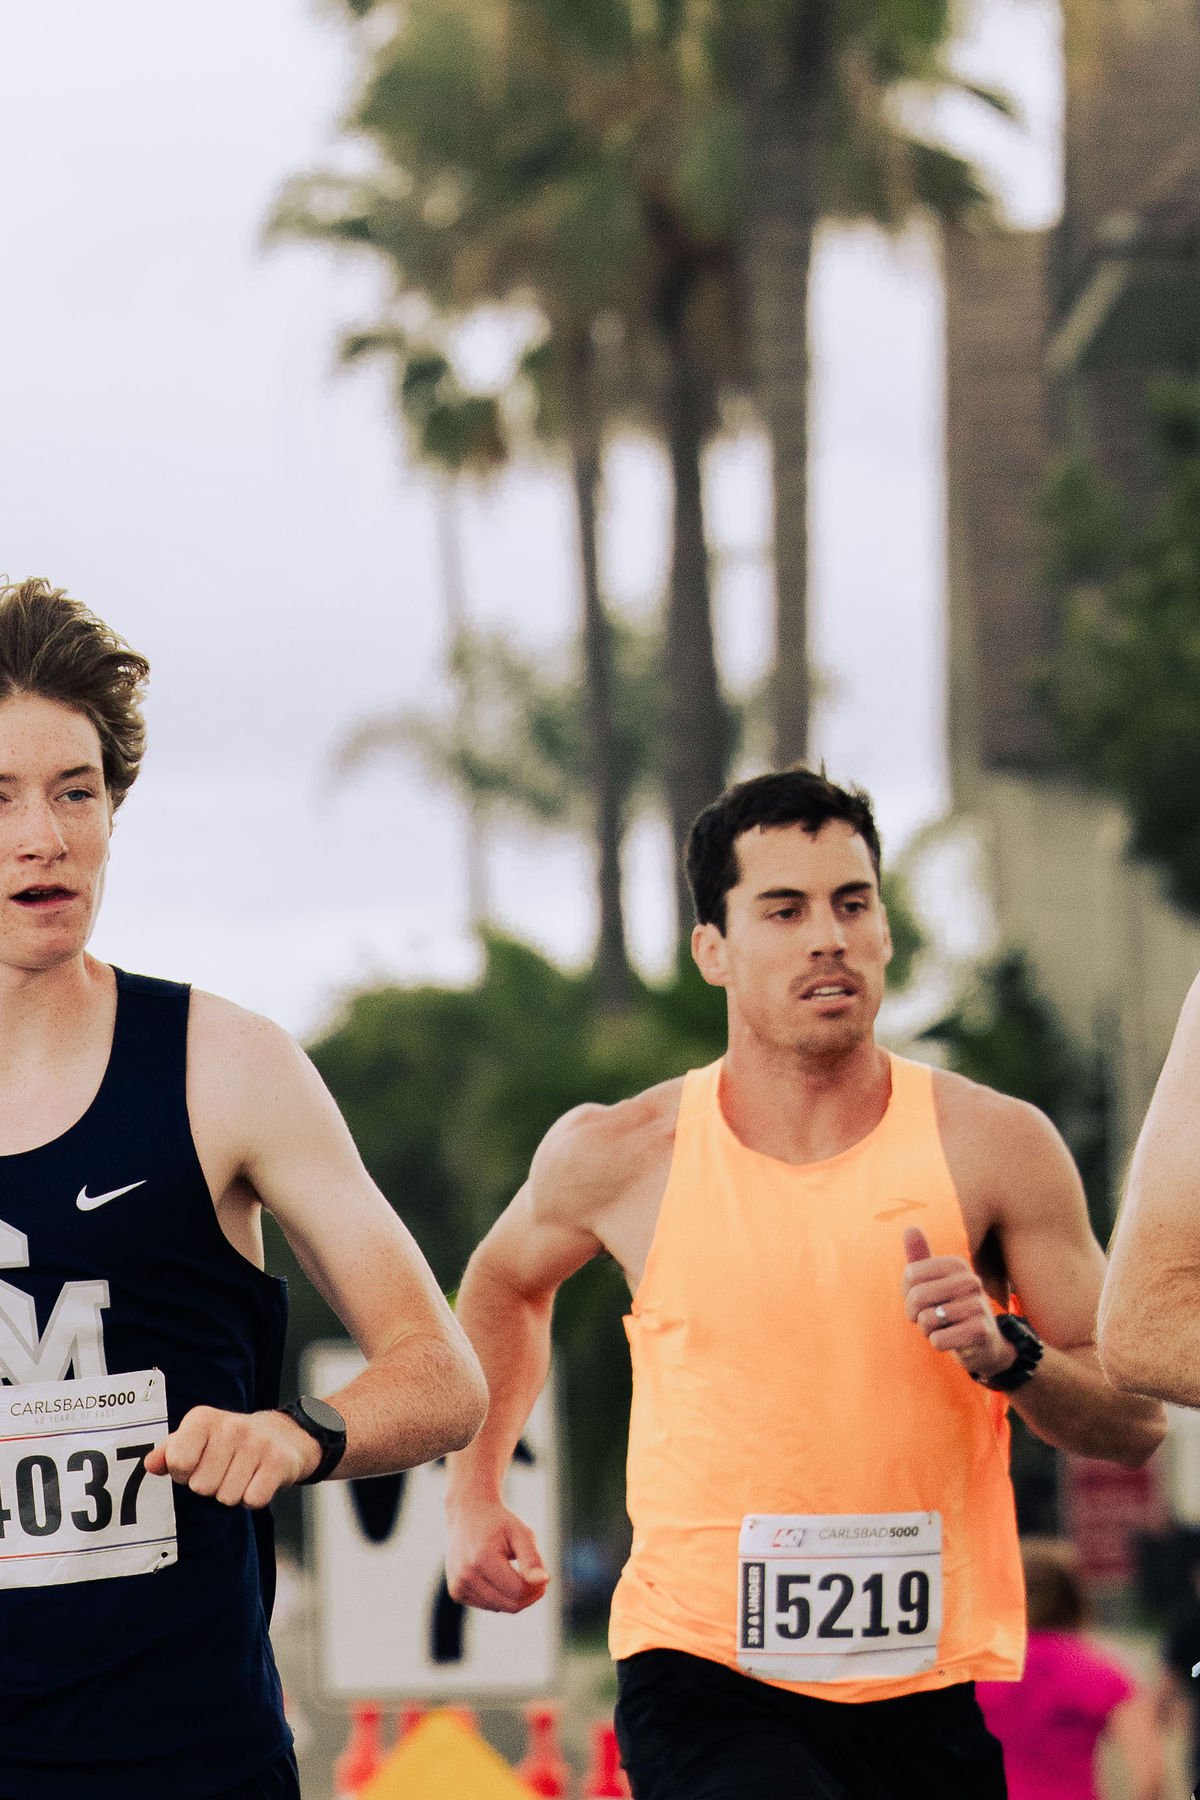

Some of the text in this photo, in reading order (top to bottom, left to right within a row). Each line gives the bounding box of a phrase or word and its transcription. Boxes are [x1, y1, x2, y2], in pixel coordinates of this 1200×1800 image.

[49, 1413, 76, 1423] YEARS
[80, 1412, 90, 1421] OF
[95, 1409, 115, 1419] FAST
[774, 1570, 930, 1640] 5219
